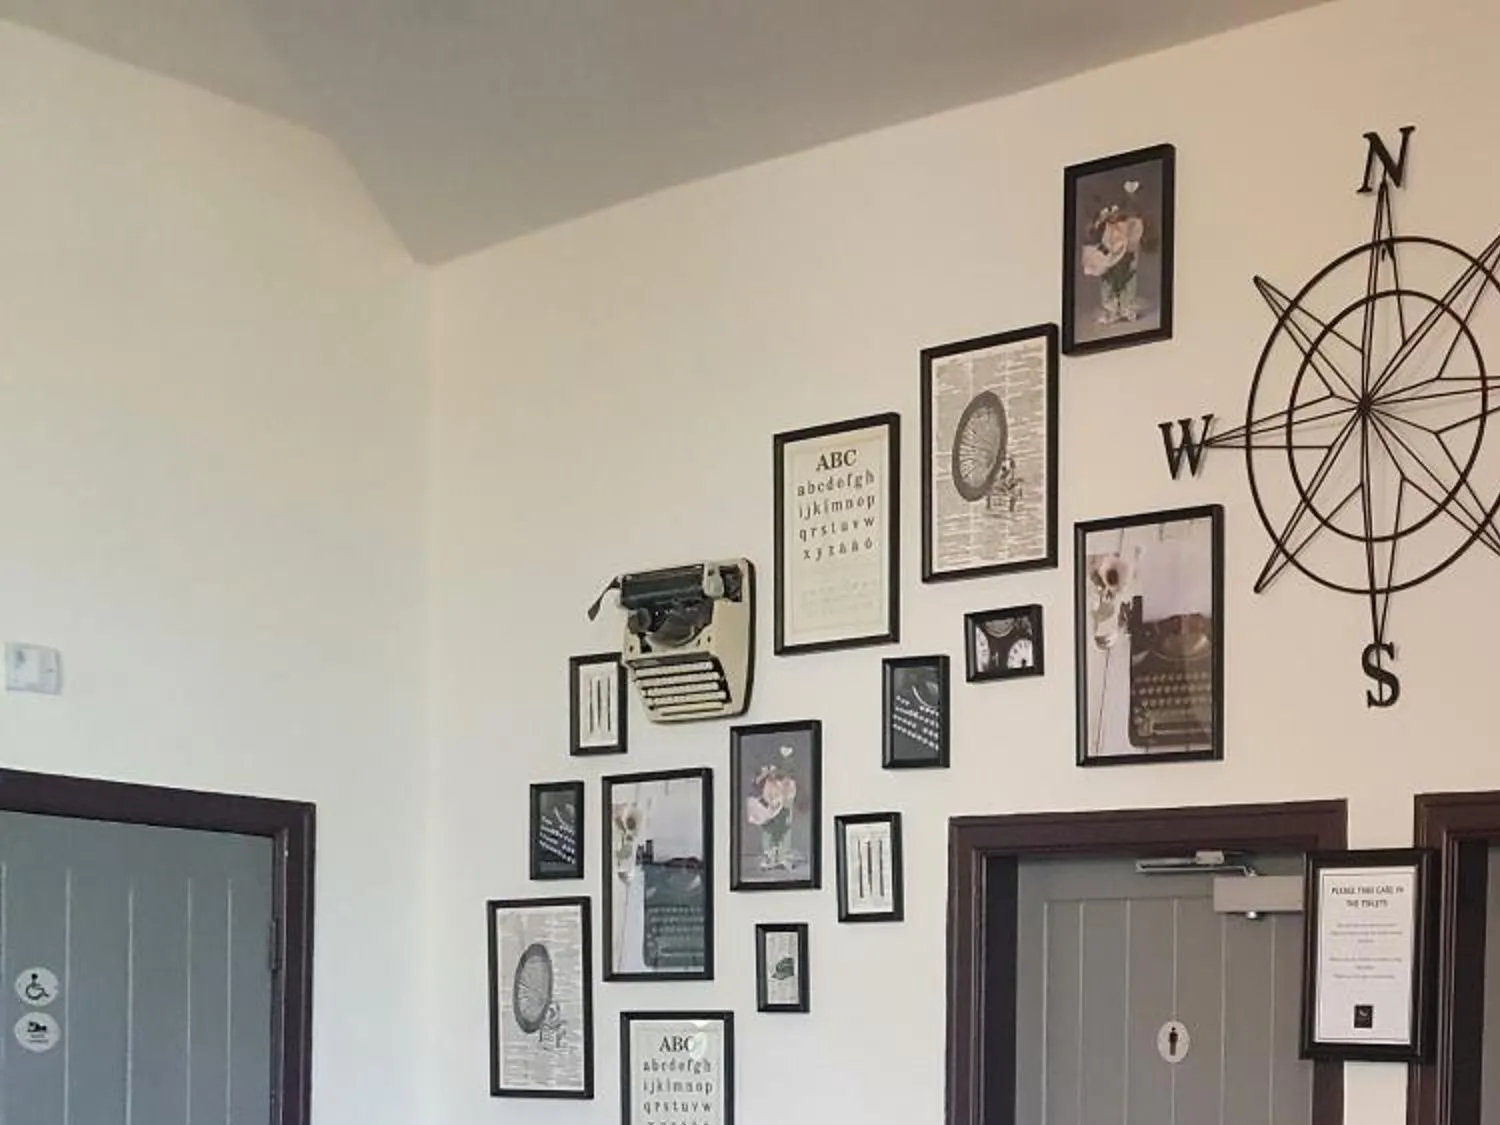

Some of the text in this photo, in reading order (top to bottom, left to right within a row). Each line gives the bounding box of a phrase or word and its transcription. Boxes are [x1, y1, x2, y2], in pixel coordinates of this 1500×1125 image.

[1357, 126, 1415, 193] N
[815, 449, 857, 471] ABC
[1158, 413, 1214, 480] W
[1361, 641, 1400, 708] S
